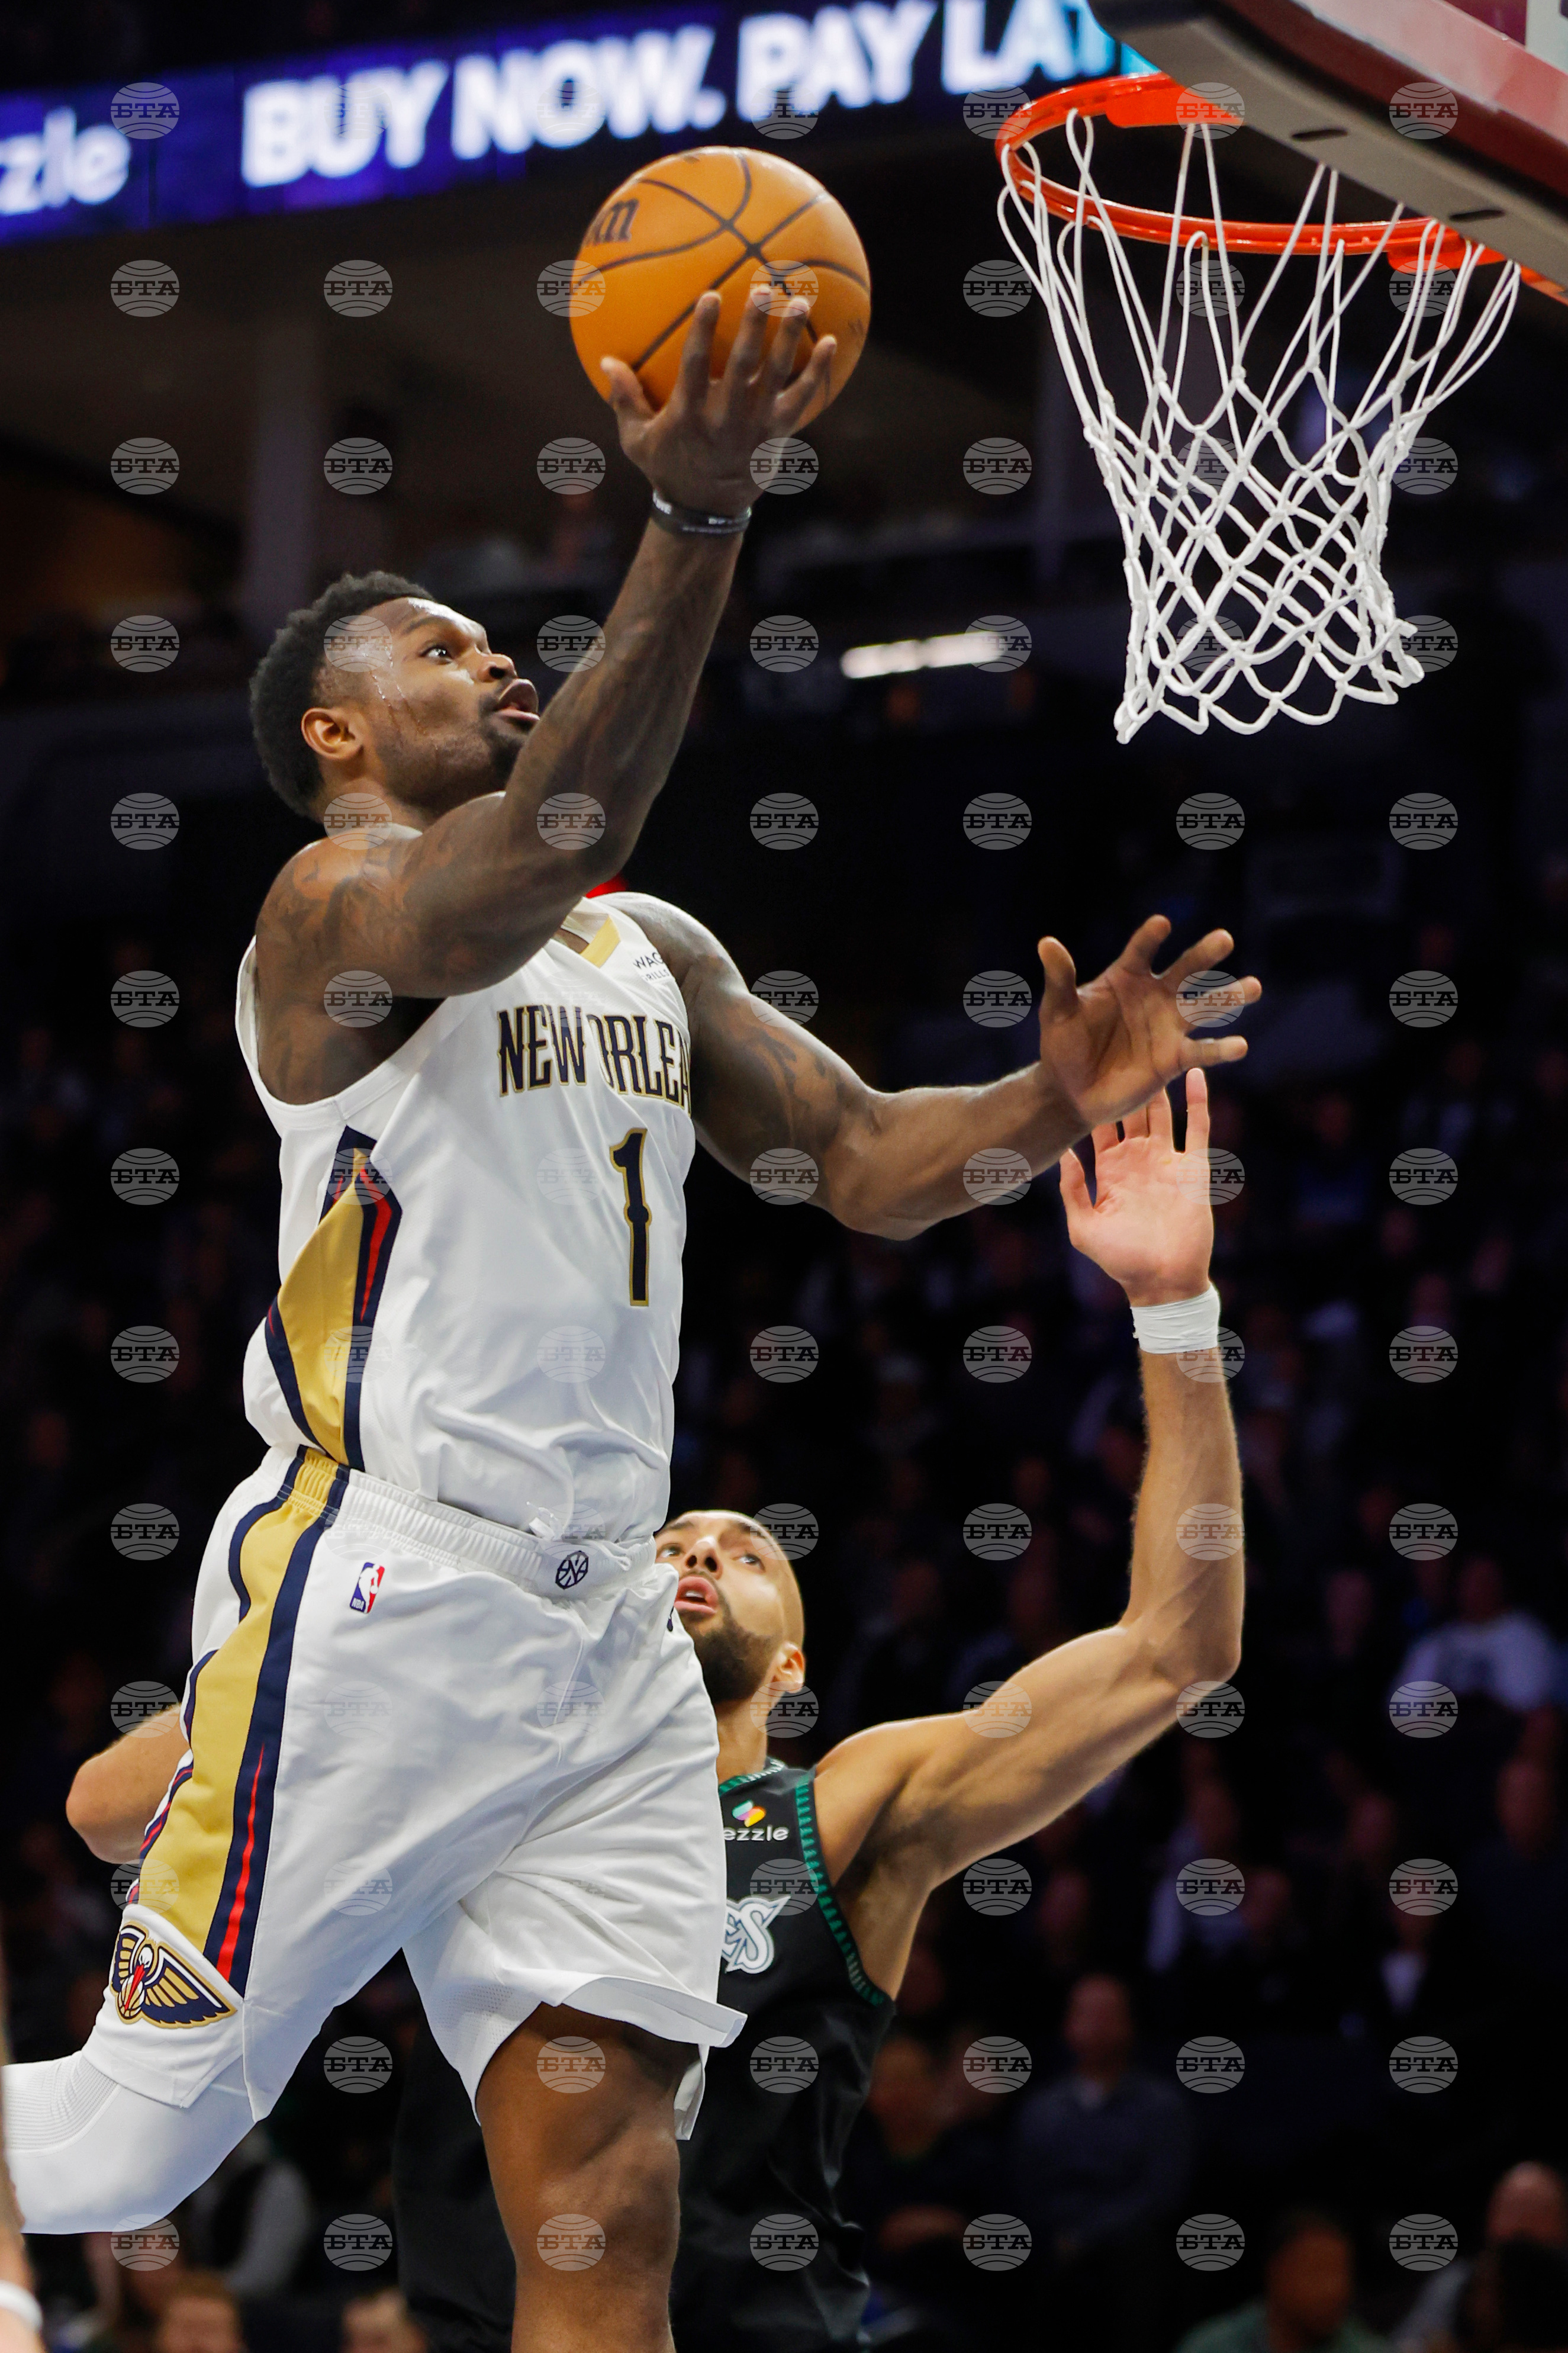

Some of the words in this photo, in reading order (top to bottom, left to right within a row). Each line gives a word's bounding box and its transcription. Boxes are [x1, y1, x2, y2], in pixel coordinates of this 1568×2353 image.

[242, 59, 449, 188] BUY
[451, 25, 727, 160] NOW.
[736, 0, 938, 121] PAY
[642, 969, 671, 981] RILLS
[497, 1003, 588, 1098] NEW
[609, 1127, 652, 1307] 1
[350, 1597, 365, 1611] NBA
